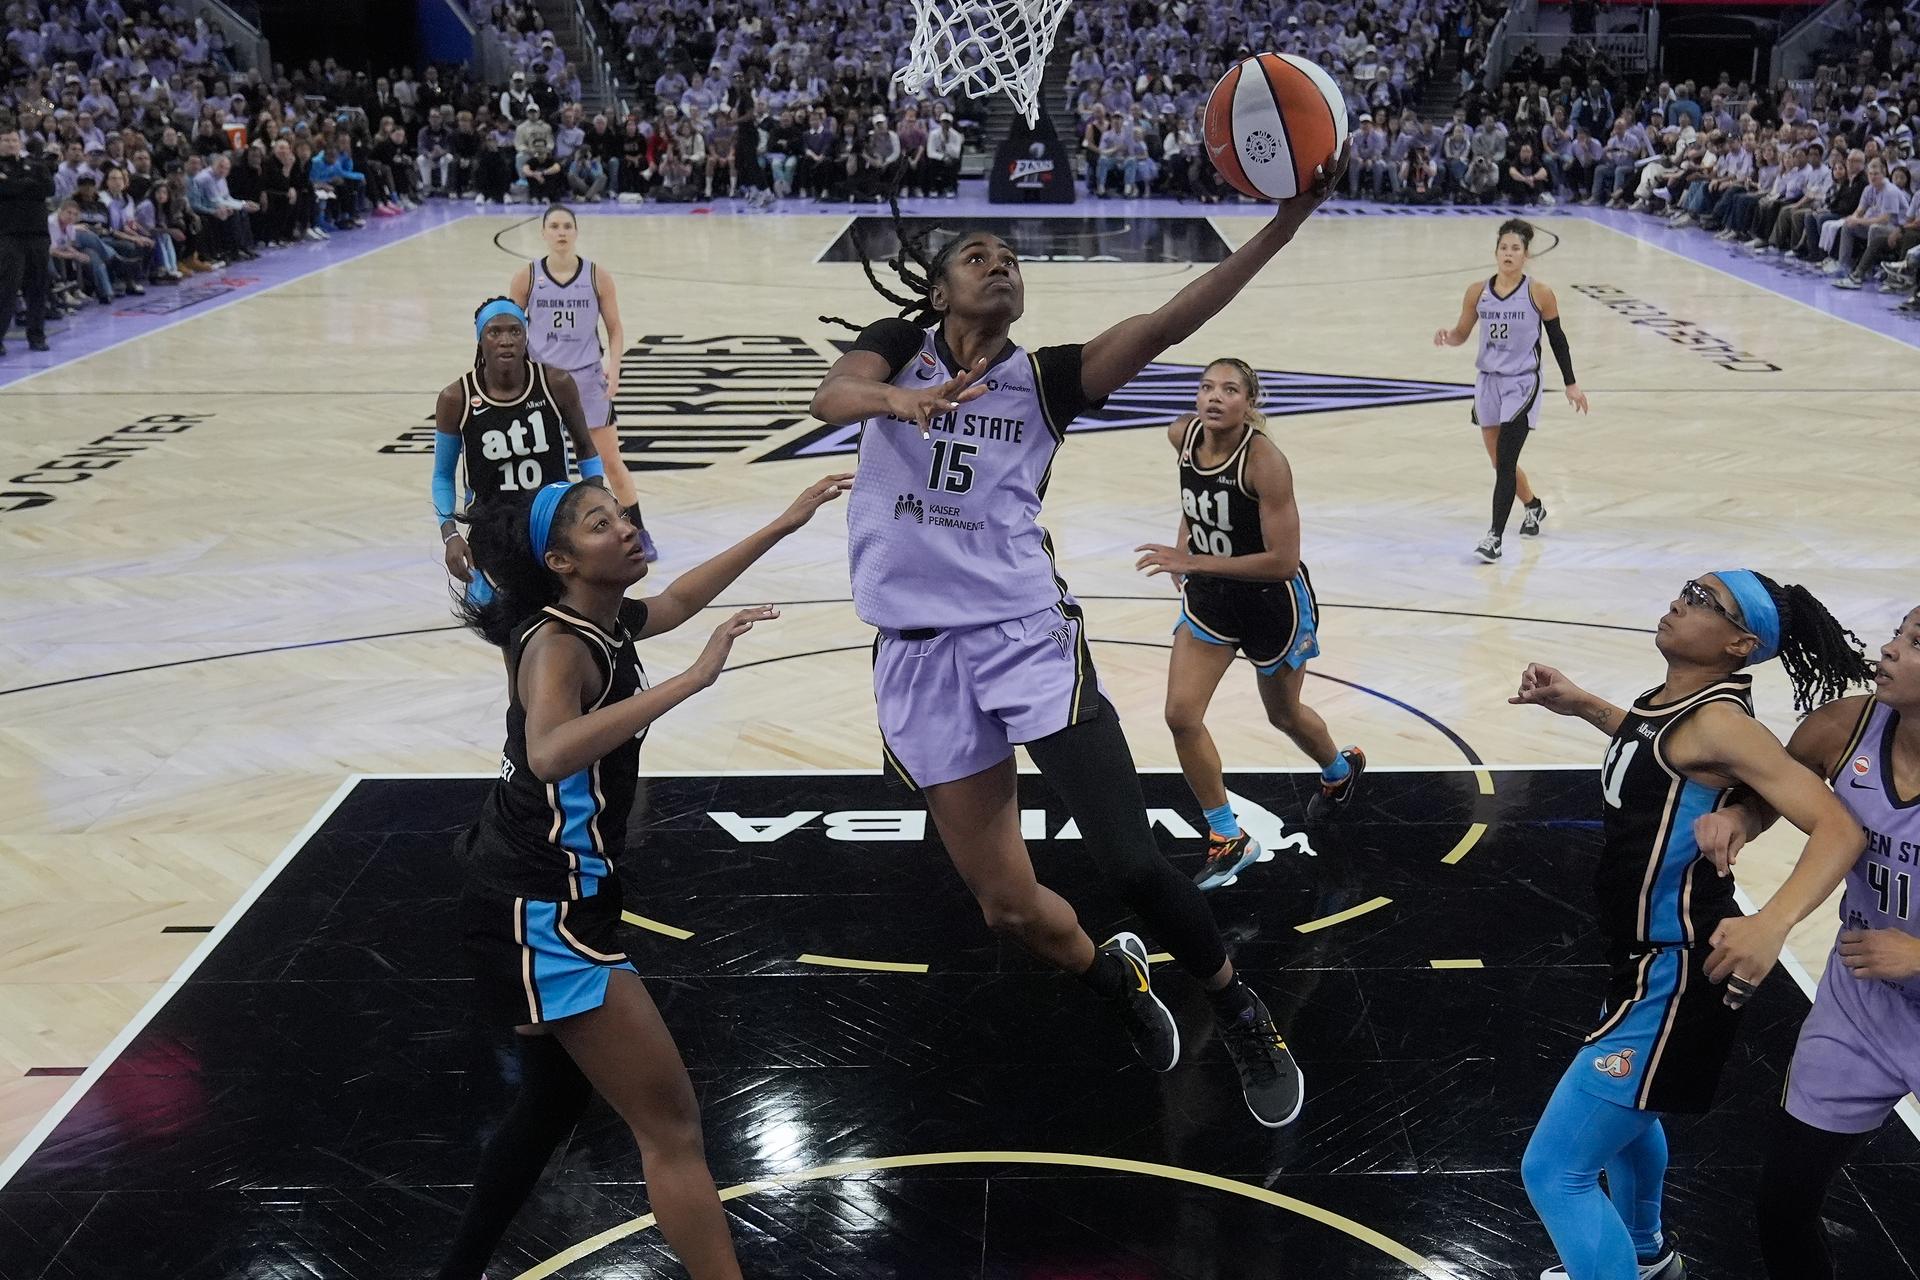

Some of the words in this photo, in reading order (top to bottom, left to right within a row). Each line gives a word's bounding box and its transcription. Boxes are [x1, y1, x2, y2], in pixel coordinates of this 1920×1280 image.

[536, 299, 564, 308] GOLDEN
[566, 299, 590, 308] STATE
[553, 311, 575, 328] 24
[1502, 311, 1526, 320] STATE
[1490, 323, 1509, 339] 22
[1000, 382, 1031, 392] freedom
[525, 399, 546, 410] Albert
[481, 410, 550, 461] atl
[963, 414, 1025, 443] STATE
[8, 413, 216, 484] CENTER
[498, 458, 543, 491] 10
[926, 439, 979, 496] 15
[929, 504, 960, 516] KAISER
[1867, 861, 1911, 921] 41
